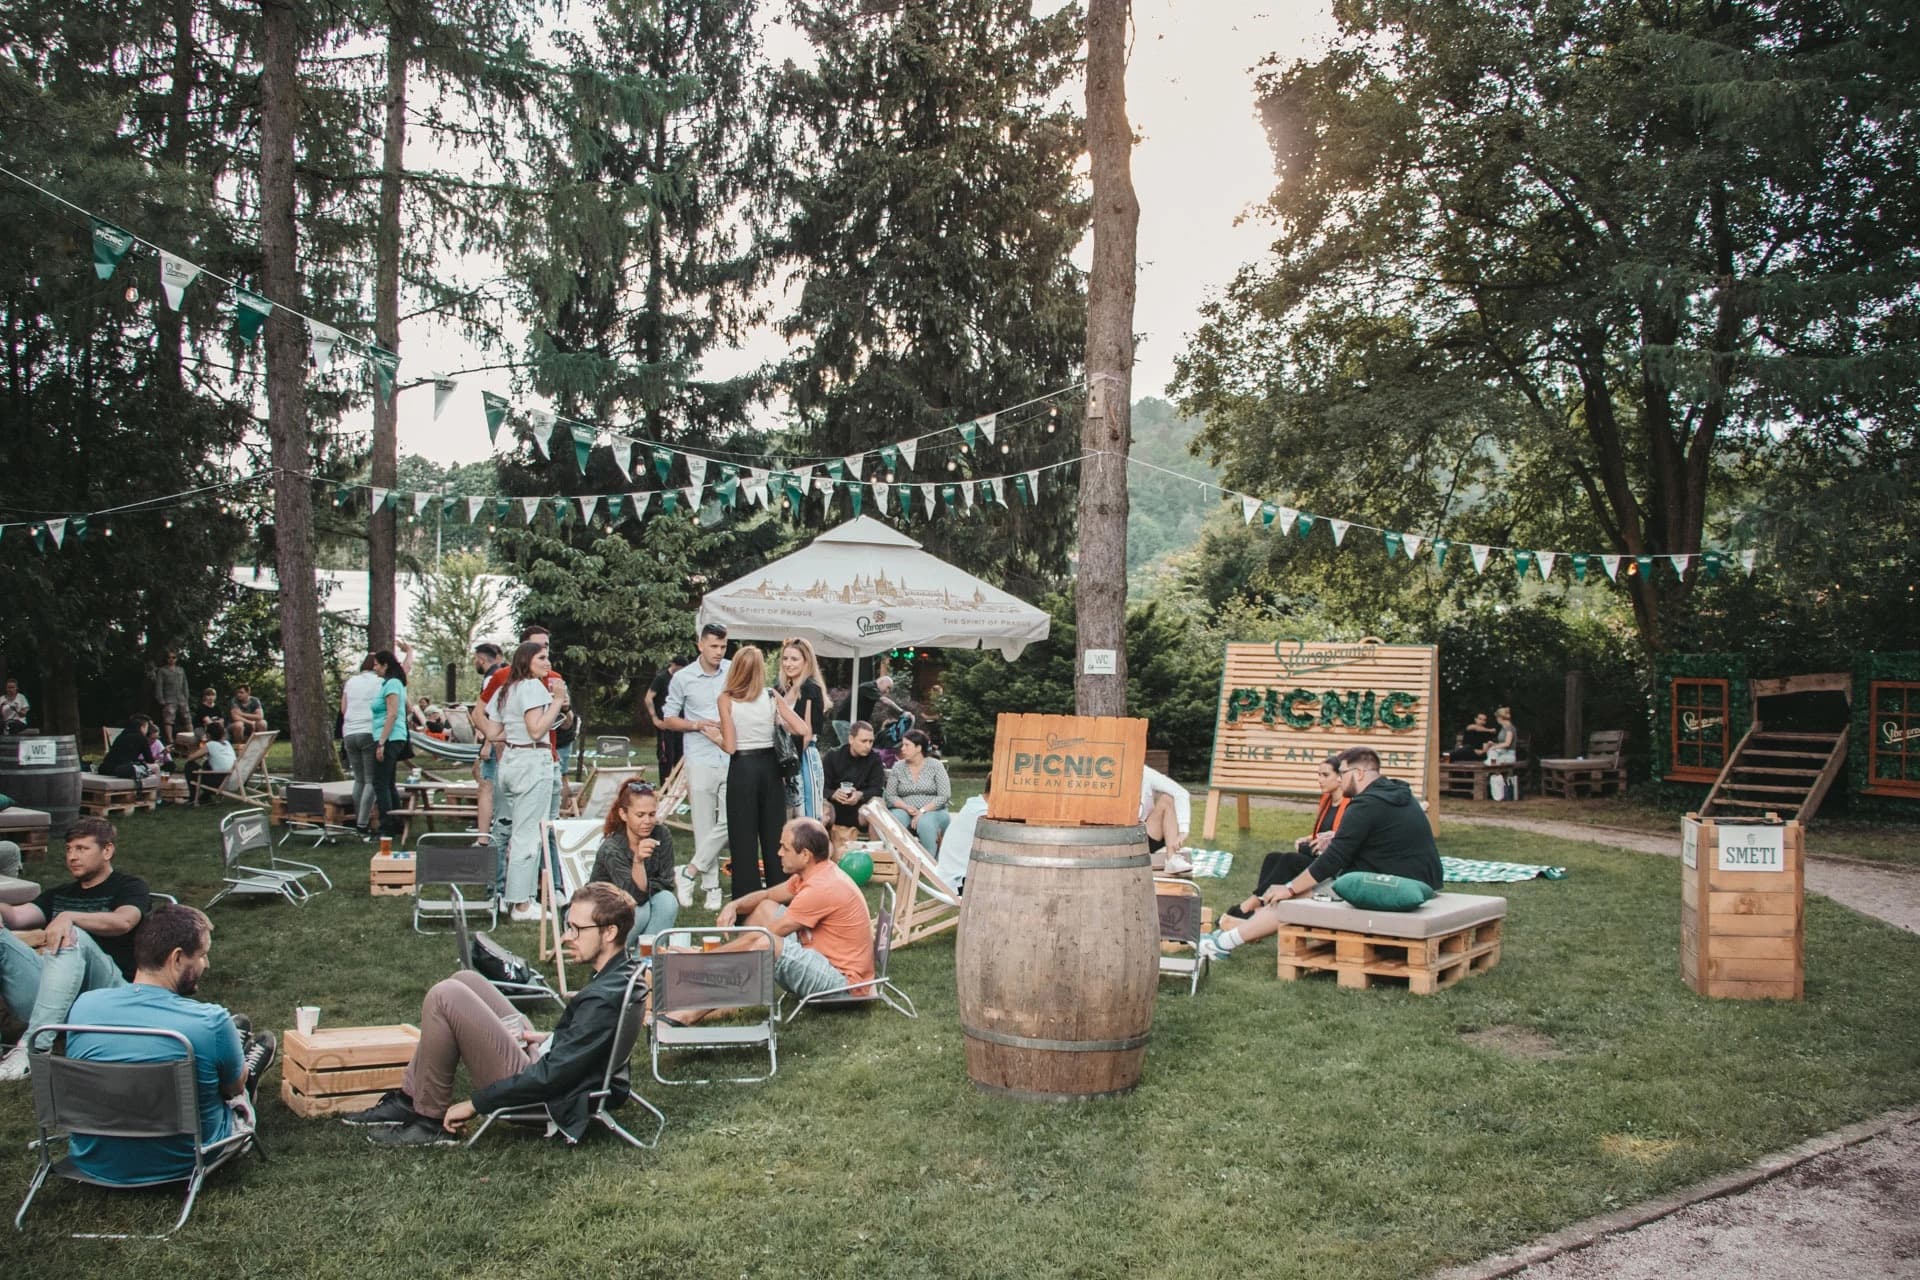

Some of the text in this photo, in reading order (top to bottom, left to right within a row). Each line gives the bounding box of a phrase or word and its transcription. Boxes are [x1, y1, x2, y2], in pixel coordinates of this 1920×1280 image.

[1094, 654, 1109, 665] WC
[1226, 688, 1421, 731] PICNIC
[32, 745, 47, 754] WC
[1225, 745, 1275, 761] LIKE
[1285, 748, 1315, 762] AN
[1014, 753, 1117, 779] PICNIC
[1012, 777, 1116, 790] LIKE AN EXPERT
[1726, 846, 1777, 865] SMETI
